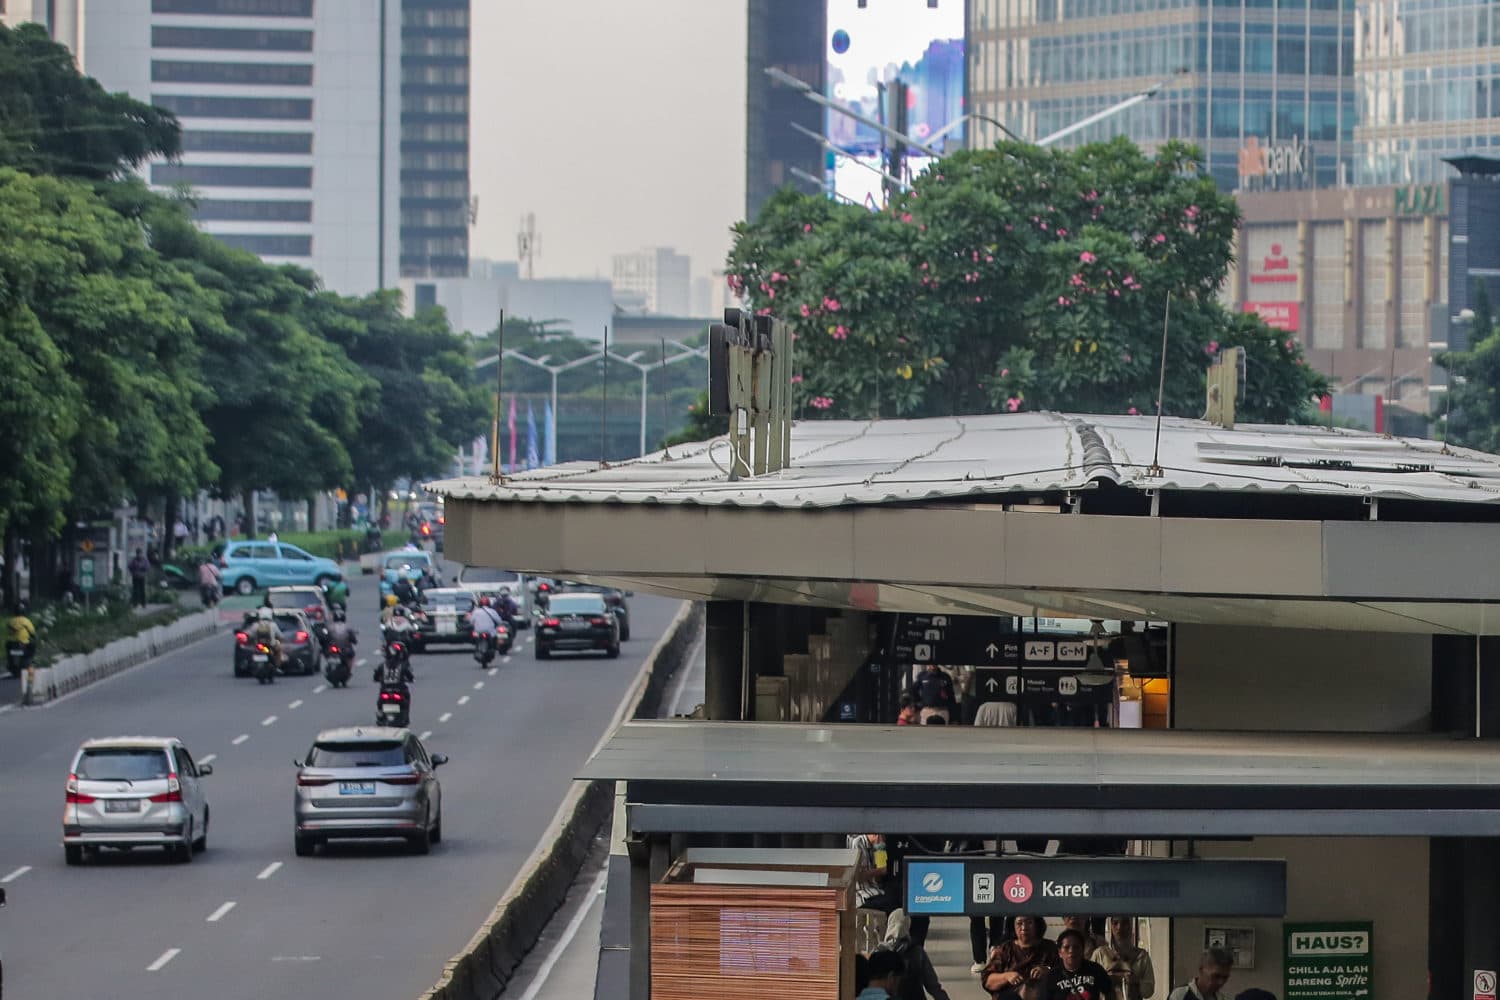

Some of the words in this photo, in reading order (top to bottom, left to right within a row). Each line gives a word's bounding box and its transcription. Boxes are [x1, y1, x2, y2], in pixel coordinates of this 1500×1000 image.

[1266, 134, 1304, 174] bank
[1395, 186, 1445, 214] PLAZA
[919, 648, 926, 657] A
[1015, 877, 1021, 886] 1
[1010, 886, 1026, 899] 08
[1042, 881, 1090, 898] Karet
[1296, 936, 1364, 950] HAUS?
[1288, 966, 1320, 974] CHILL
[1322, 966, 1345, 974] AJA
[1346, 965, 1368, 973] LAH
[1288, 978, 1332, 986] BARENG
[1335, 974, 1368, 988] Sprite
